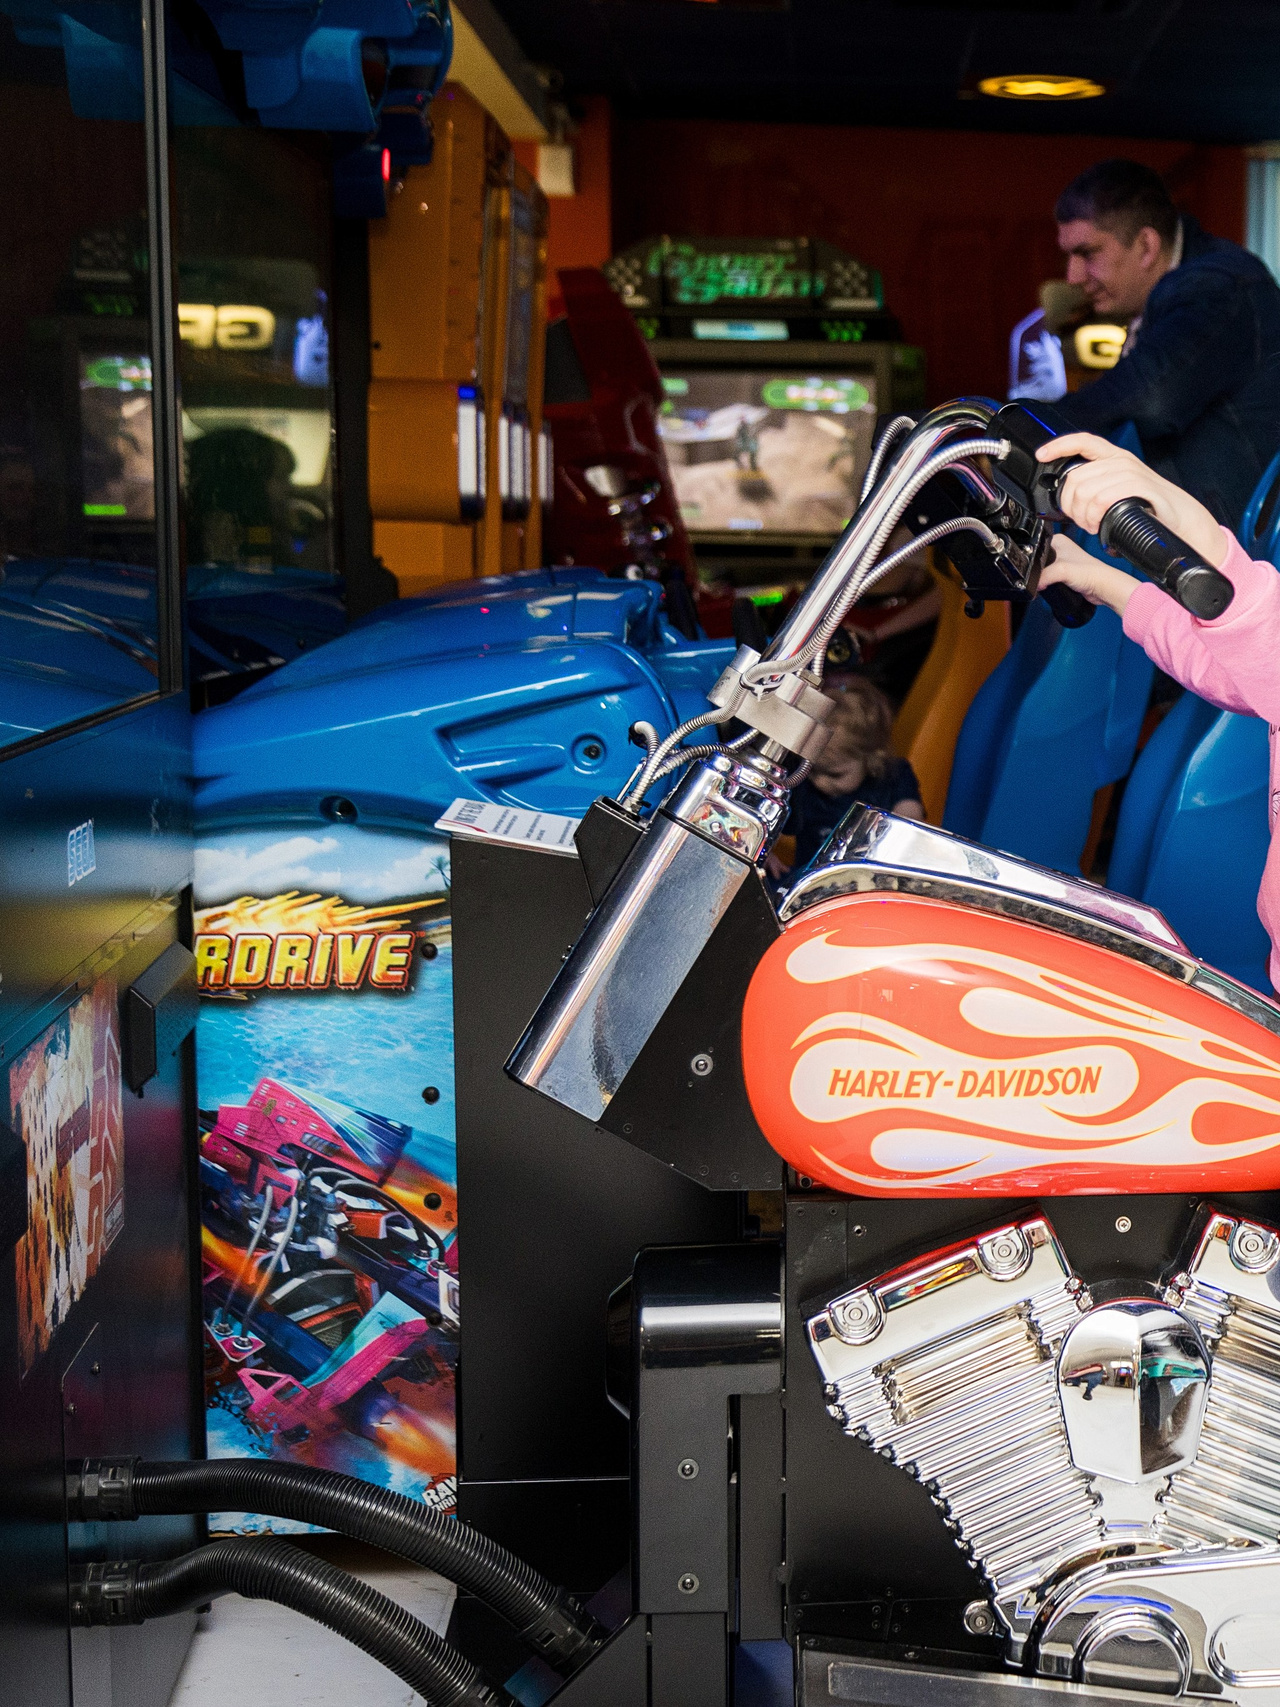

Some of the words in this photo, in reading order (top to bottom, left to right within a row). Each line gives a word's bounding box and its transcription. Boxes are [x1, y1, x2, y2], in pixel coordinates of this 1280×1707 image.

[67, 818, 96, 887] SEGA
[196, 931, 414, 988] RDRIVE
[828, 1065, 1102, 1098] HARLEY-DAVIDSON
